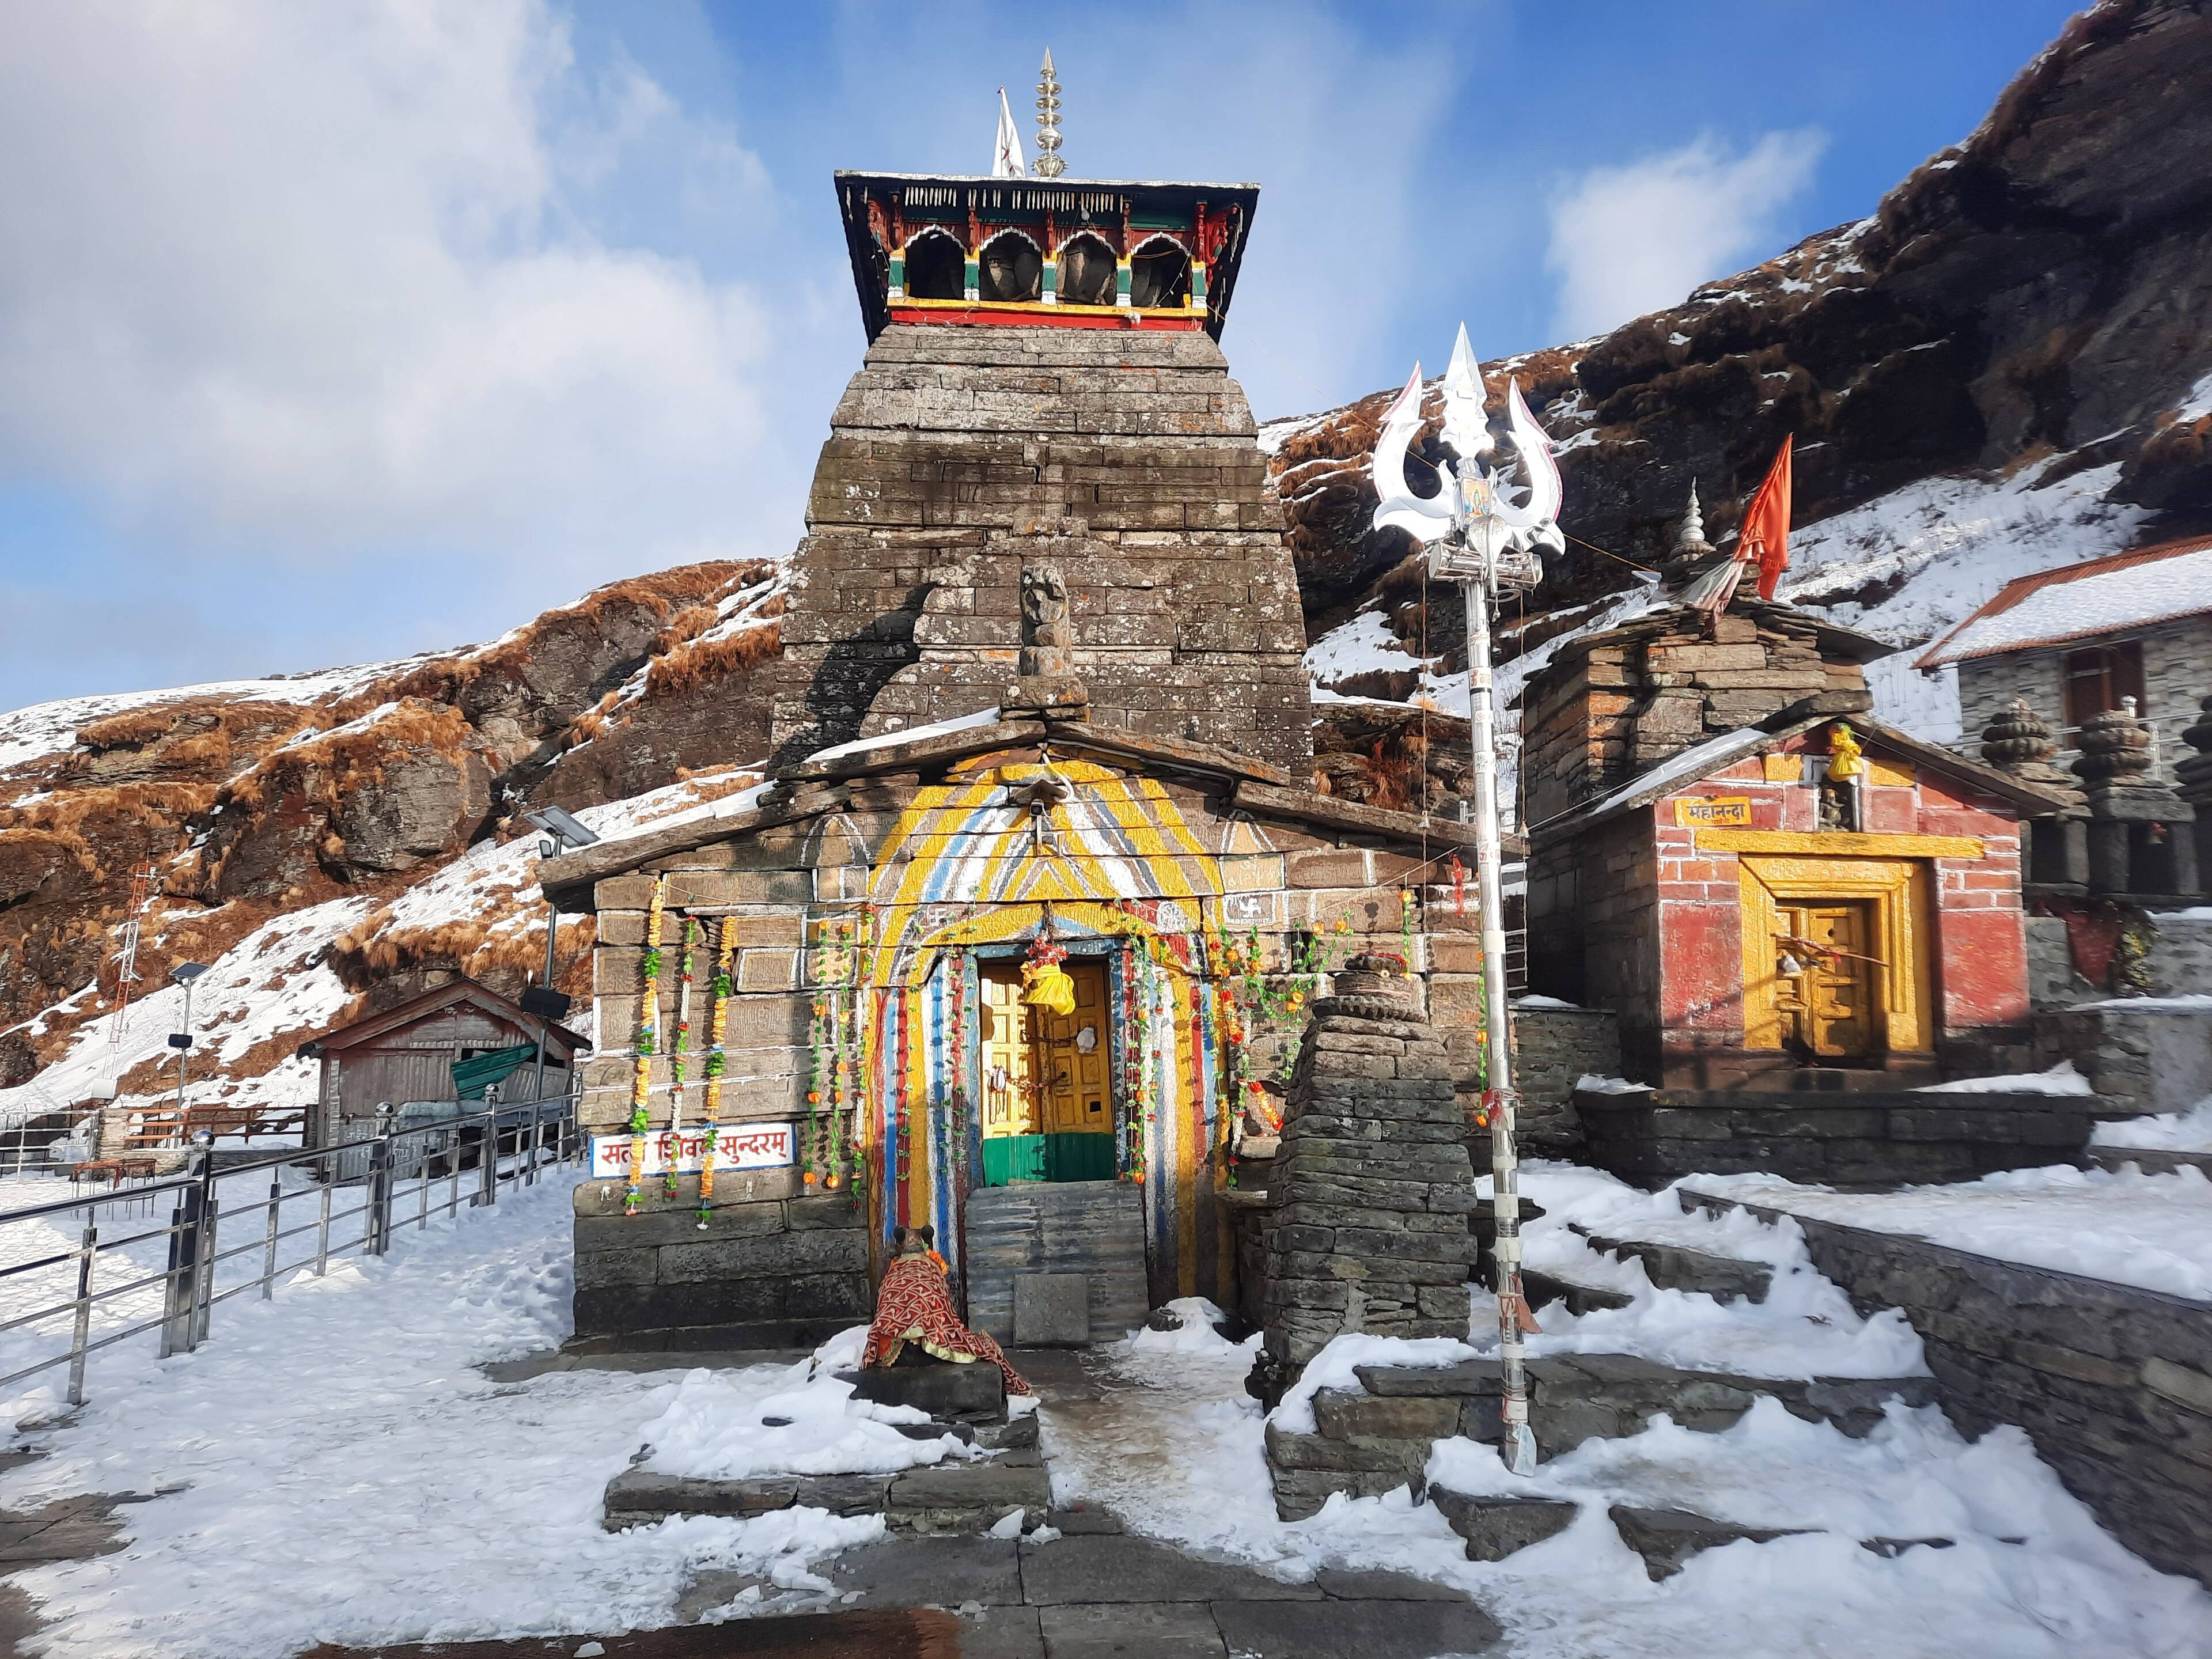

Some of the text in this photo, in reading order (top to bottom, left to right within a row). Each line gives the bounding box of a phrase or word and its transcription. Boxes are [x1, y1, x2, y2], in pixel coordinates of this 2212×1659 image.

[1686, 804, 1745, 820] महानन्दा
[602, 1142, 647, 1164] सत्
[719, 1132, 786, 1164] सुन्दरम्
